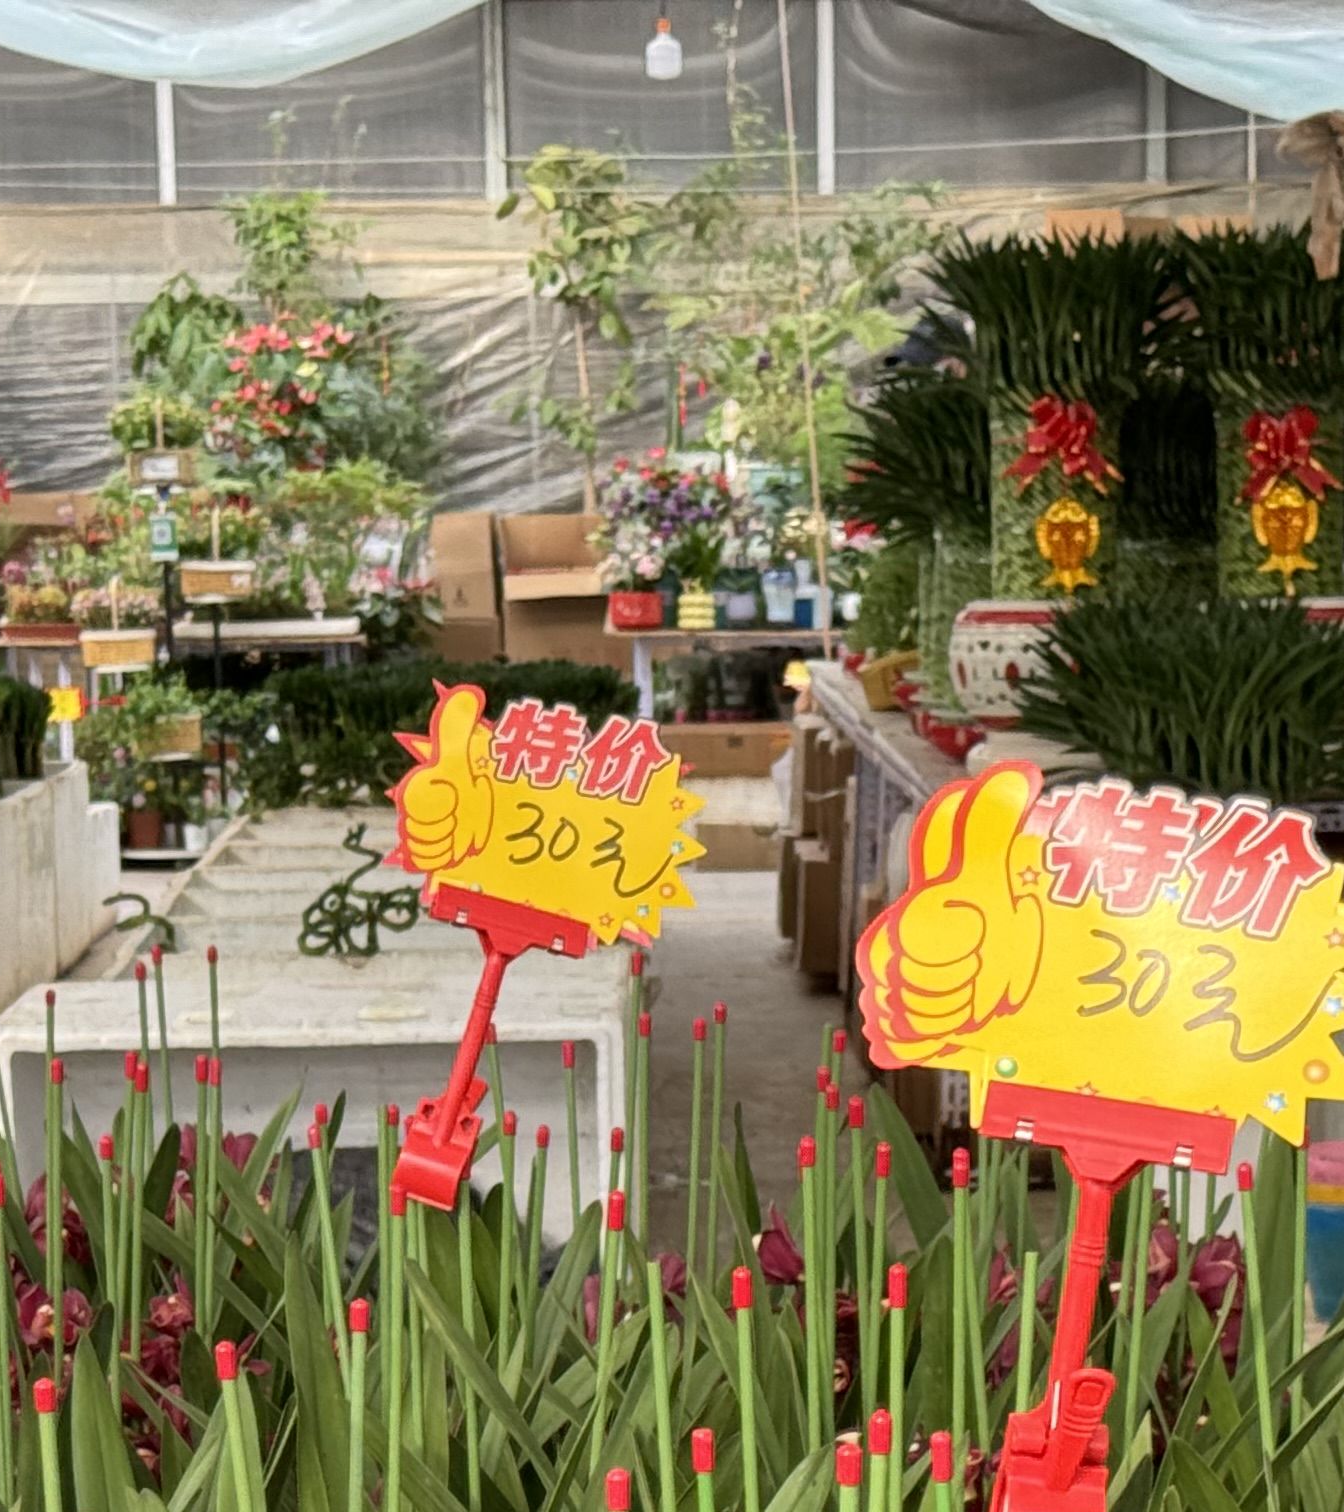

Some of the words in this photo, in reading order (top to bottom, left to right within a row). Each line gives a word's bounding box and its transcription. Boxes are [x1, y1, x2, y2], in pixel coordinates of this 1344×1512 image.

[494, 699, 670, 804] 特价
[505, 802, 674, 897] 30元
[1045, 778, 1331, 938] 特价
[1076, 929, 1338, 1062] 30元
